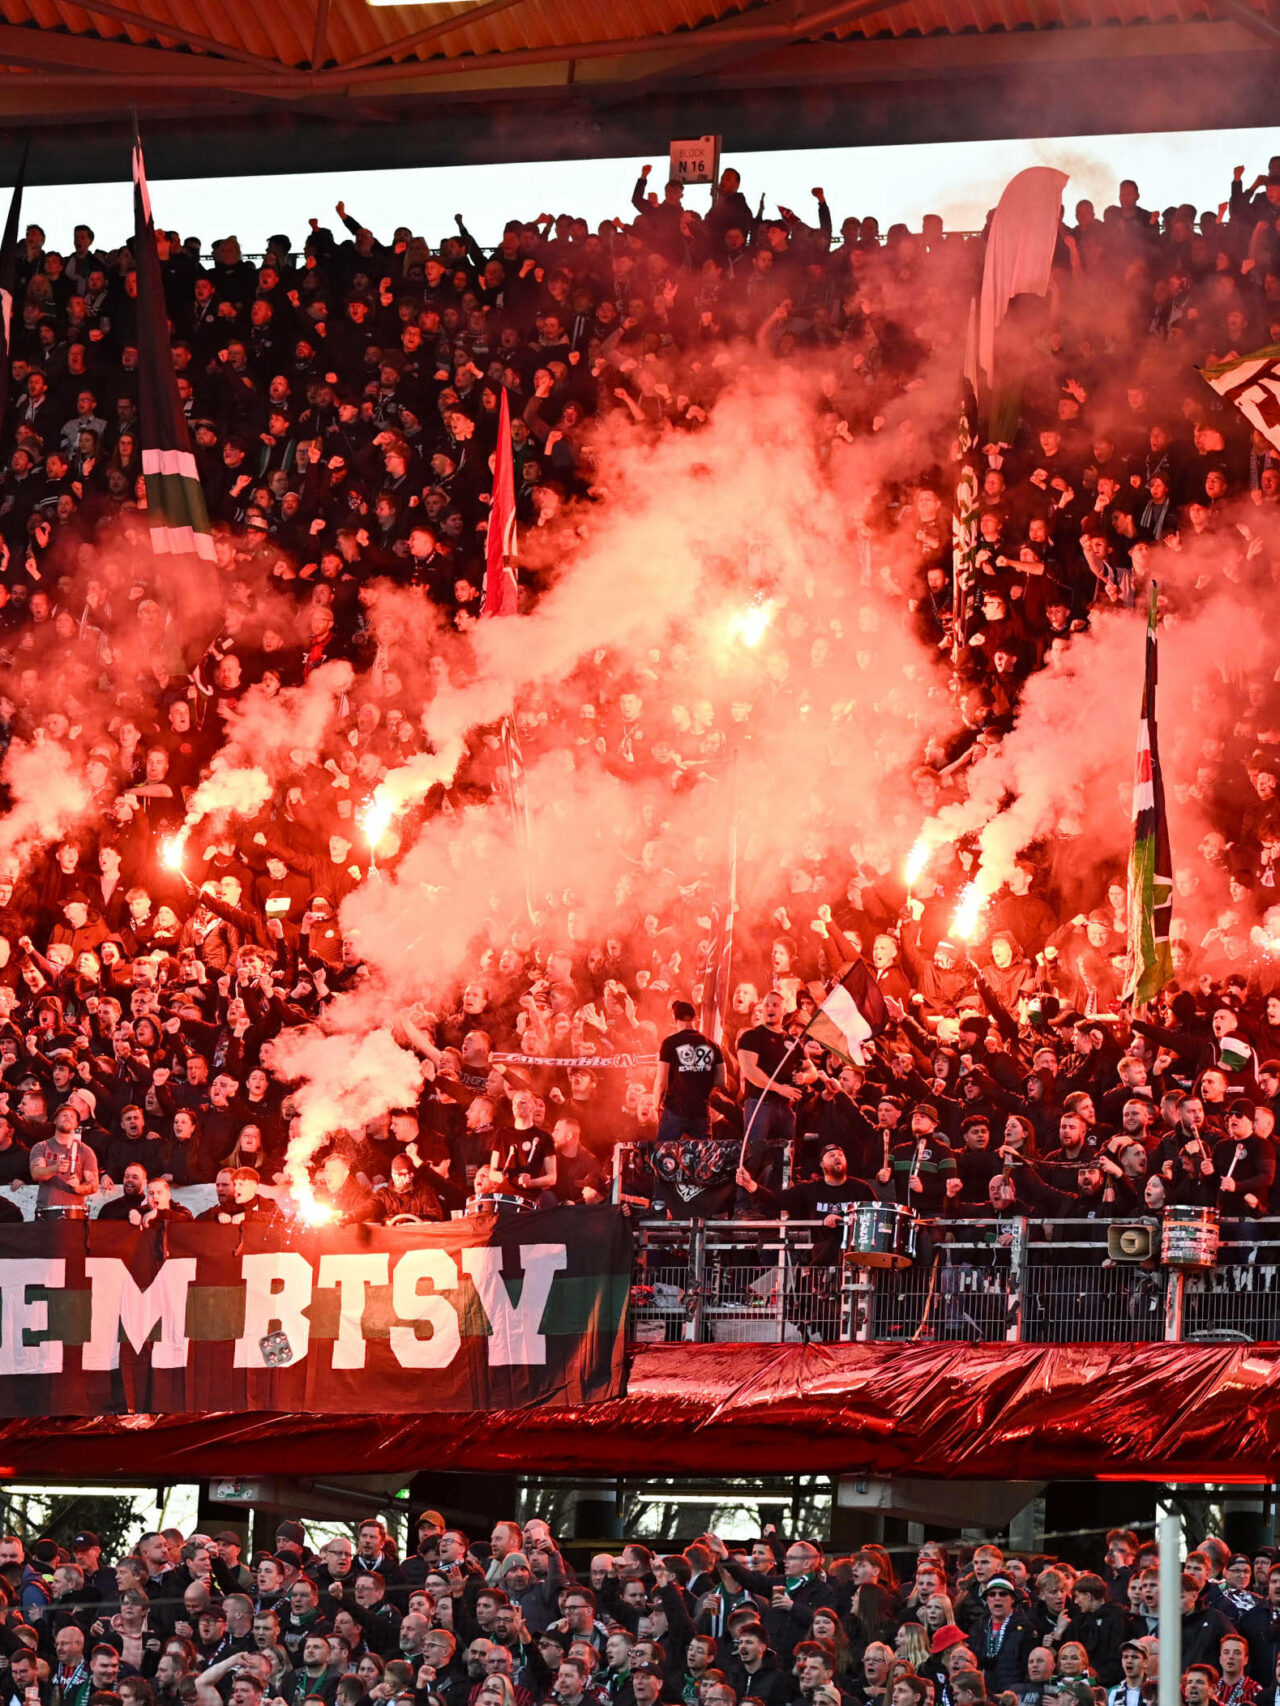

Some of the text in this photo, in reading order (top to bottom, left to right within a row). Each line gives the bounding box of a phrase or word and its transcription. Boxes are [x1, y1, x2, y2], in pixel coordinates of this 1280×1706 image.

[679, 148, 705, 158] BLOCK
[679, 160, 705, 173] N 16
[695, 1048, 712, 1065] 96
